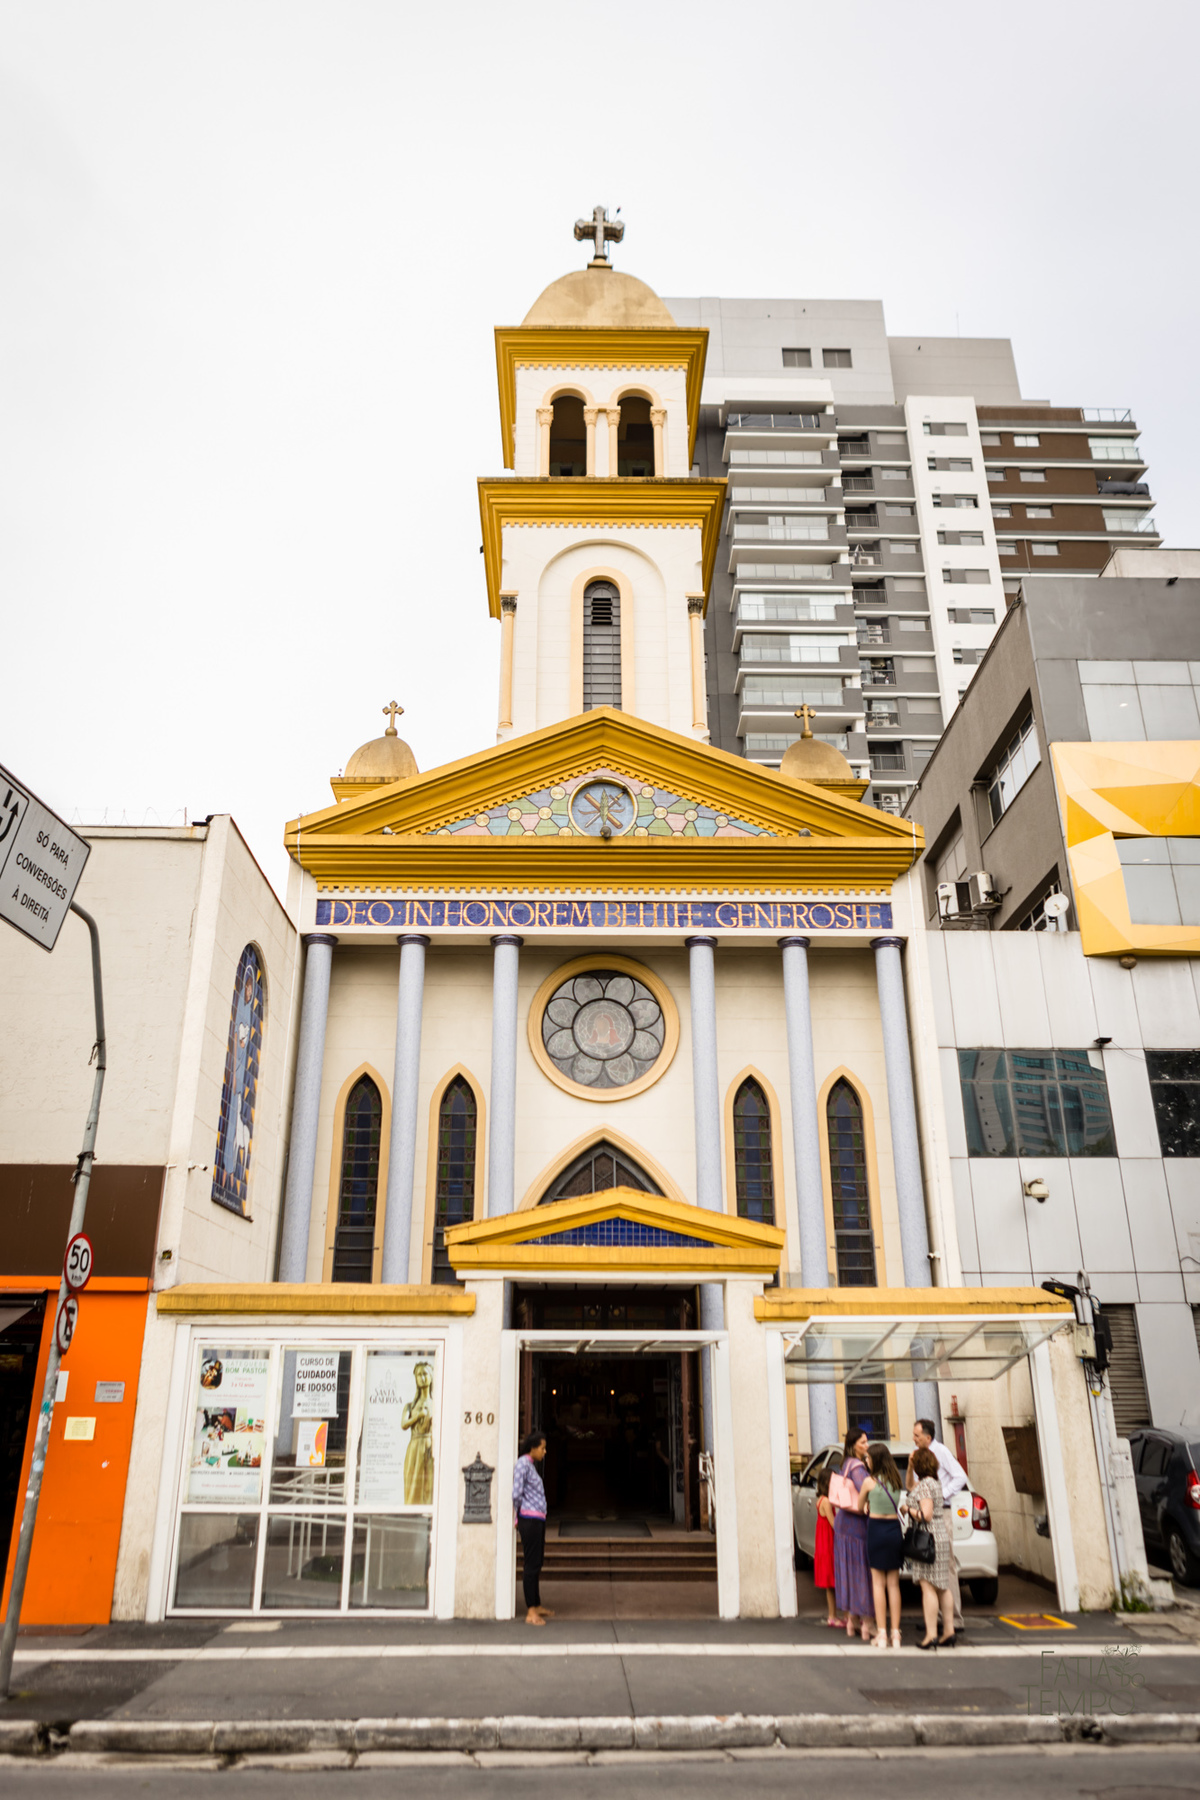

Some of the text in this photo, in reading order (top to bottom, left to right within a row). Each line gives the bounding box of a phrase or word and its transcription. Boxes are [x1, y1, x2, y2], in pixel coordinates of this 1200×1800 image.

[36, 830, 69, 866] SÓ PARA
[16, 852, 68, 900] CONVERSÕES
[20, 893, 50, 923] DIREITA
[328, 901, 394, 926] DEO
[403, 901, 434, 926] IN
[442, 901, 594, 927] HONOREM
[69, 1244, 90, 1273] 50
[300, 1358, 334, 1366] CURSO DE
[297, 1370, 337, 1379] CUIDADOR
[296, 1383, 337, 1392] DE IDOSOS
[369, 1395, 403, 1404] GENEROSA
[464, 1411, 495, 1425] 360
